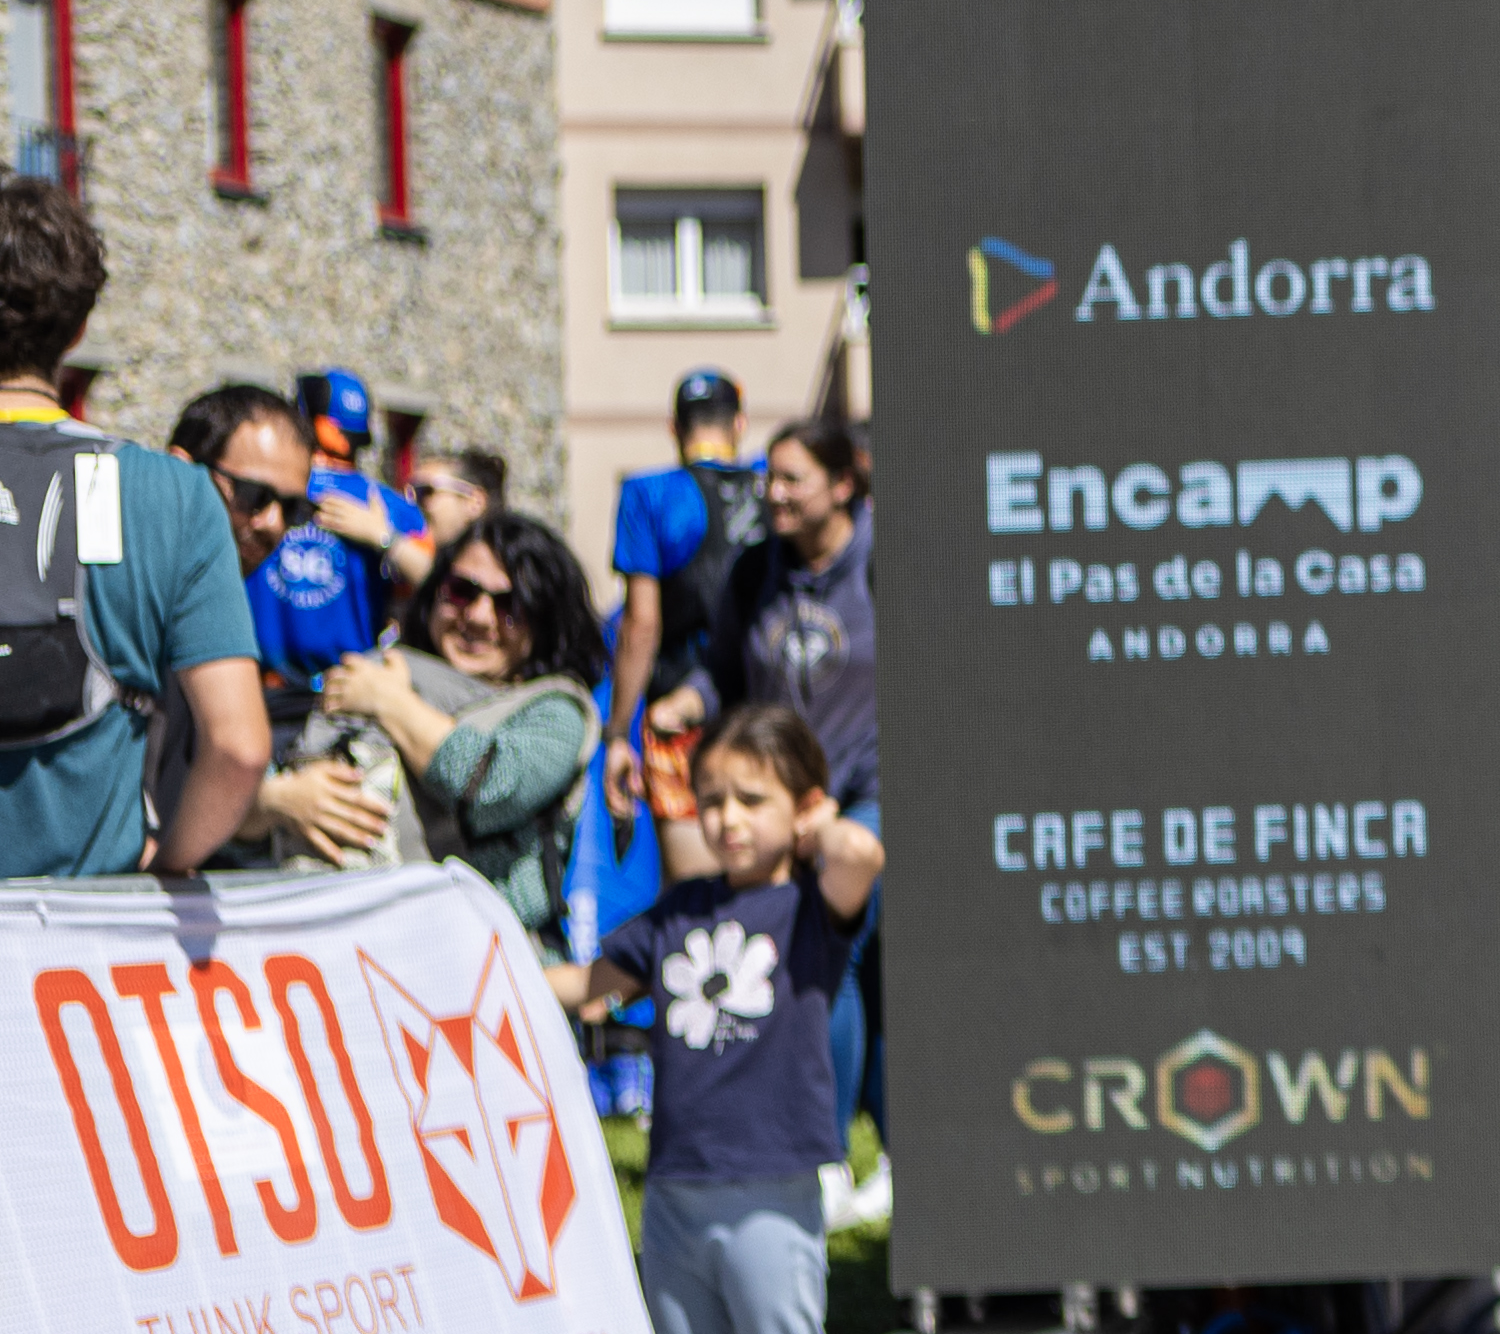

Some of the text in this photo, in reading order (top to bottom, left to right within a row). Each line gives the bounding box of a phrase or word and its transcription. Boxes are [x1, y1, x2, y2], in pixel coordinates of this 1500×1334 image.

[1075, 240, 1435, 323] Andorra
[986, 452, 1423, 533] Encamp
[989, 549, 1425, 605] El Pas de la Casa
[1088, 623, 1329, 662] ANDORRA
[993, 799, 1428, 871] CAFE DE FINCA
[1040, 871, 1387, 924] COFFEE ROASTERS
[1208, 927, 1307, 971] 2009
[33, 954, 392, 1271] OTSO
[1012, 1028, 1431, 1152] CROWN
[1014, 1152, 1433, 1197] SPORT NUTRITION
